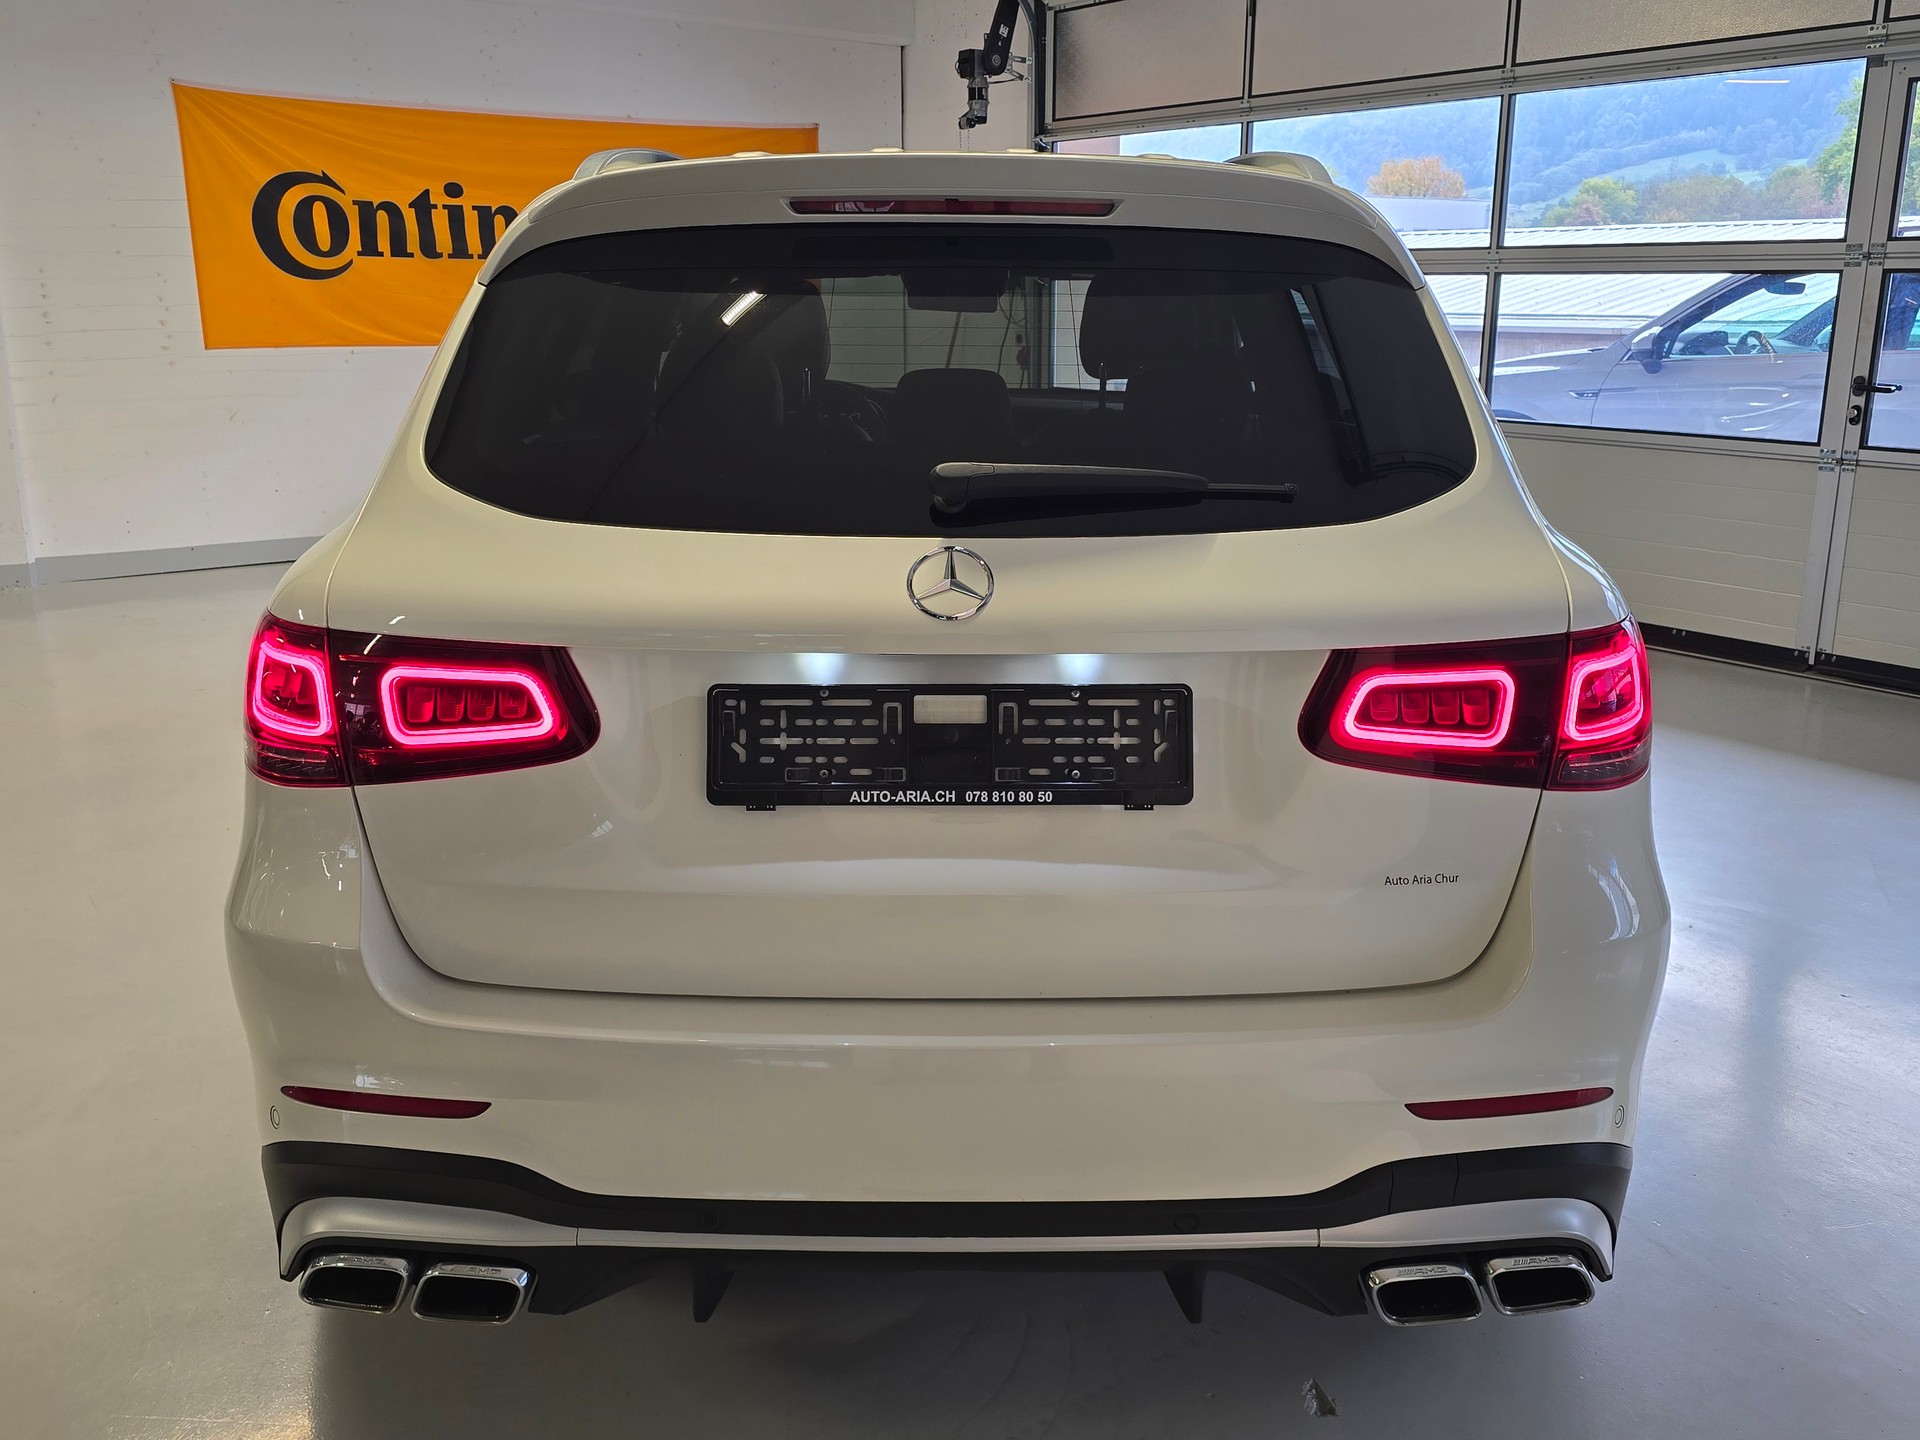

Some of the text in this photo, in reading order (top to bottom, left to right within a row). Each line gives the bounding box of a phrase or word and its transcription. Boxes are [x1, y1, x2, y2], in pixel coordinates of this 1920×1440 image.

[849, 790, 1053, 803] AUTO-ARIA.CH 078 810 80 50
[1384, 873, 1459, 886] Auto Aria Chur
